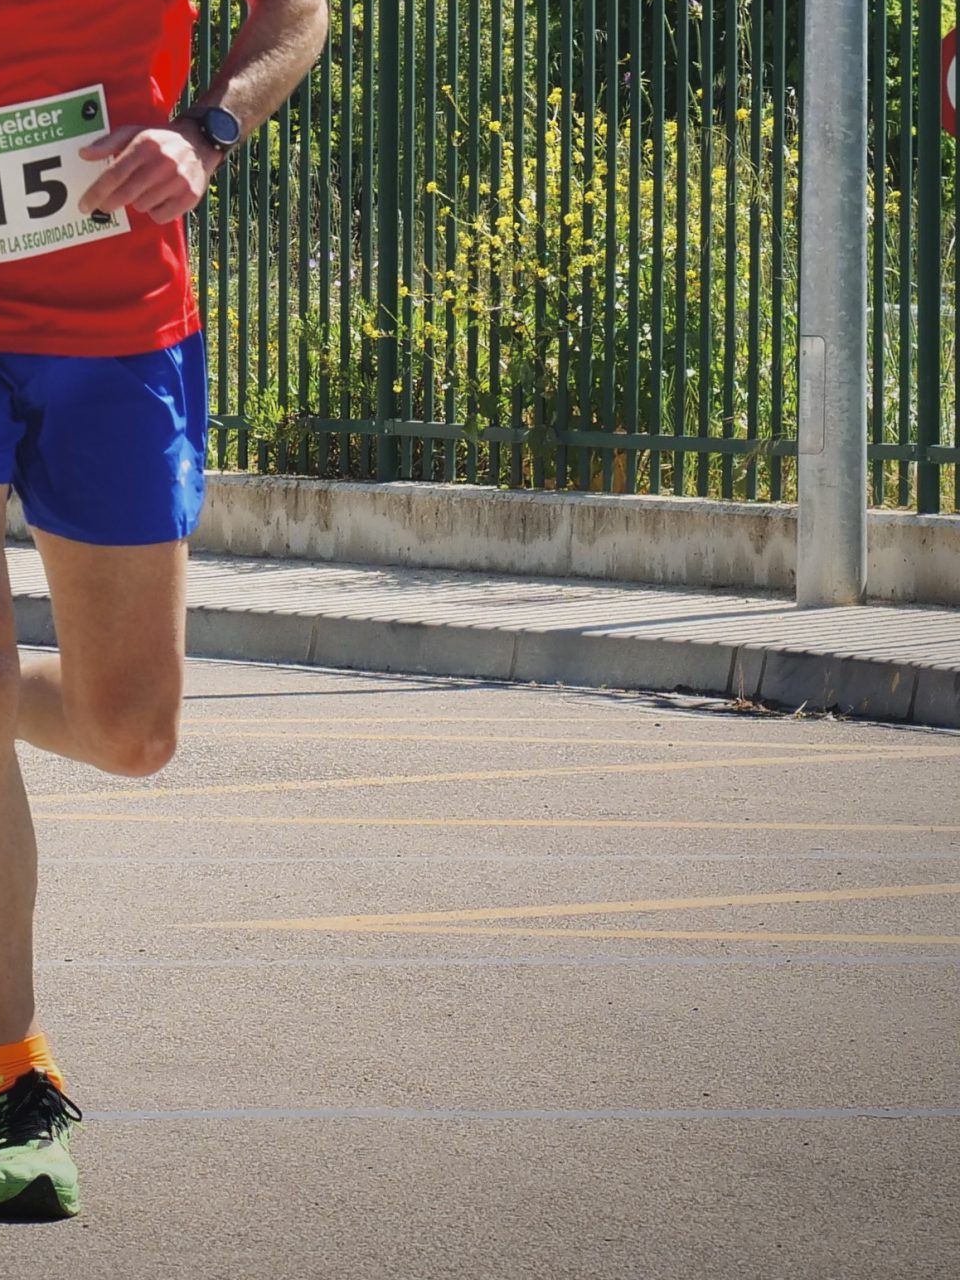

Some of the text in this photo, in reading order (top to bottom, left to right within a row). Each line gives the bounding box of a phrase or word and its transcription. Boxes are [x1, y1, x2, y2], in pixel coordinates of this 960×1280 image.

[0, 127, 64, 149] Electric
[7, 235, 22, 253] LA
[22, 222, 75, 250] SEGURIDAD
